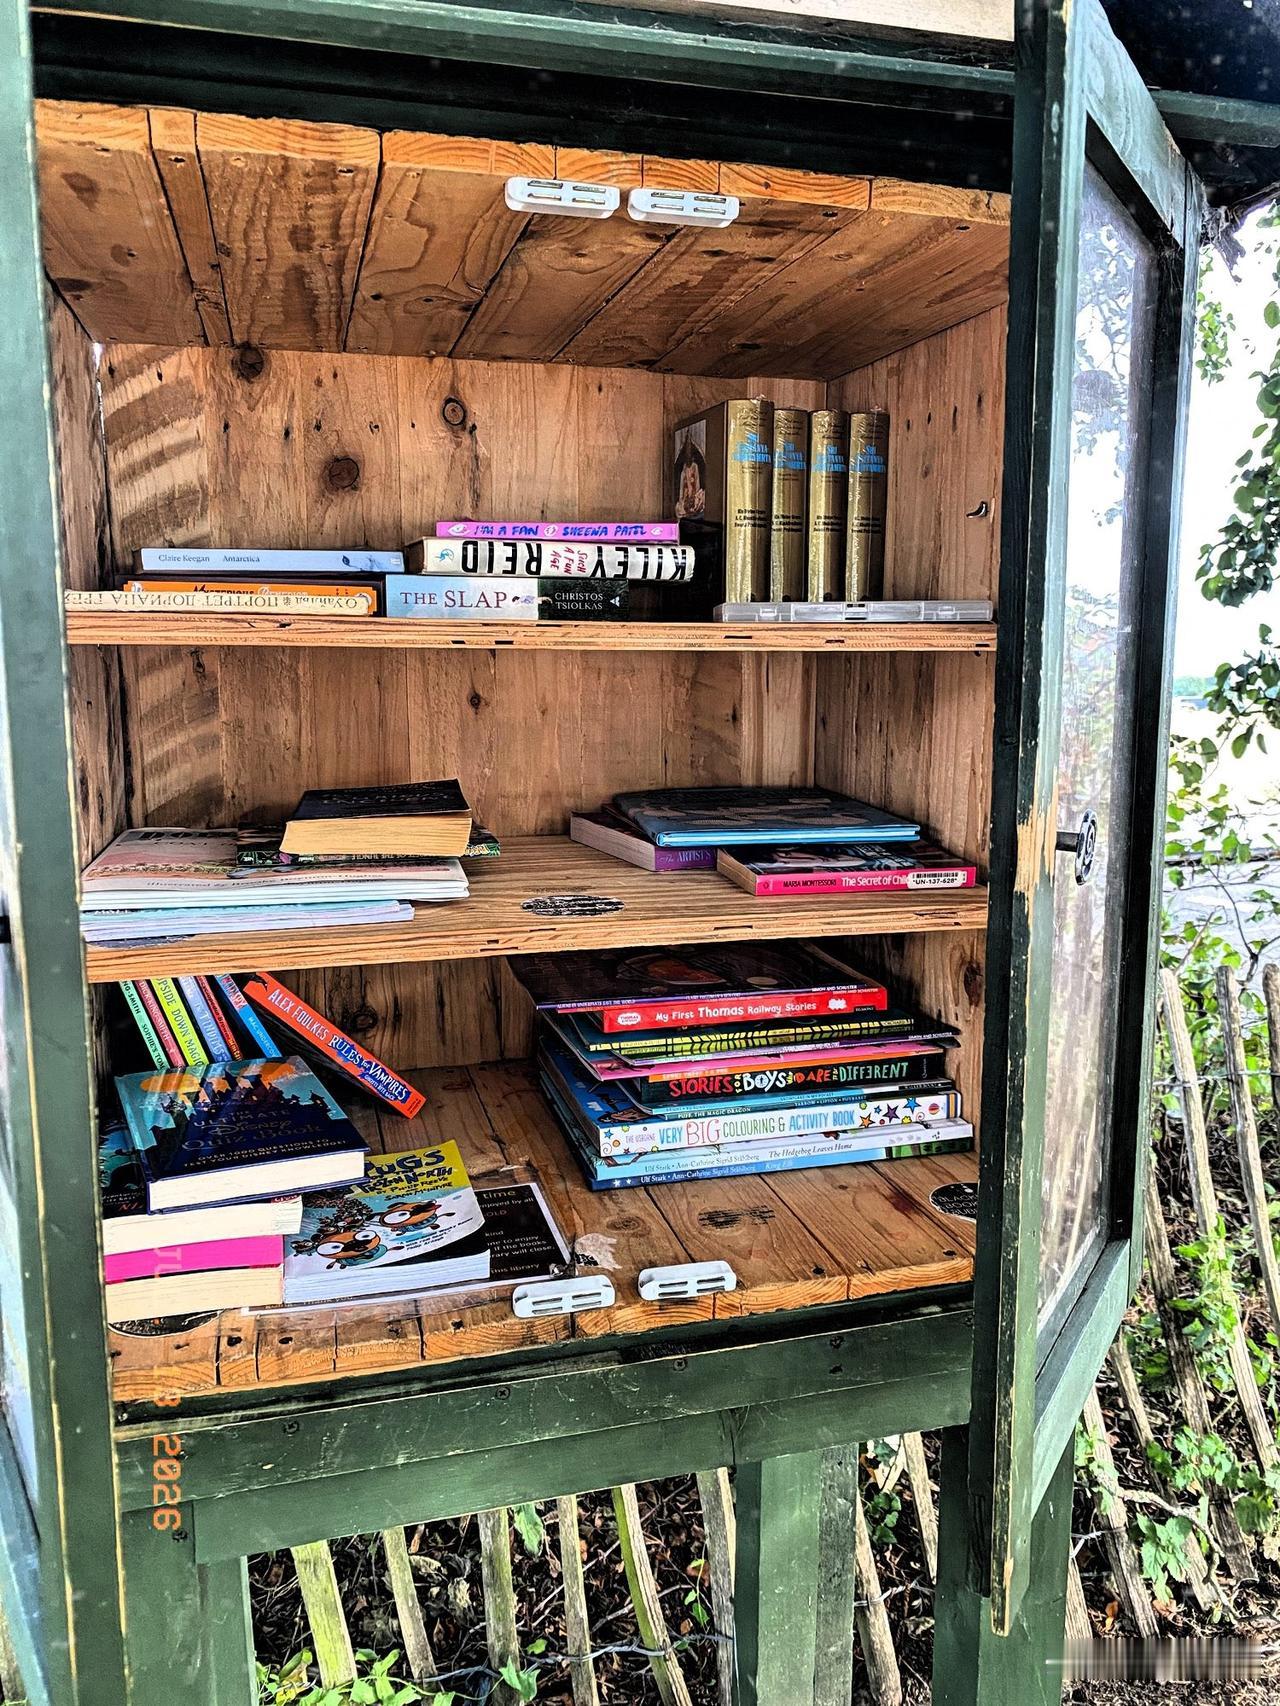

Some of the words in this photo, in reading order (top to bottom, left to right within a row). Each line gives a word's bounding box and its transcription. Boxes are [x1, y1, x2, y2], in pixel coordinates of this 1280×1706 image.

[498, 526, 507, 536] A
[511, 525, 539, 537] FAN
[562, 525, 608, 537] SHEENA
[614, 524, 647, 537] PATEL
[158, 554, 181, 563] Claire
[182, 554, 211, 565] Keegan
[222, 554, 261, 564] Antarctica
[461, 541, 543, 576] REID
[590, 545, 687, 580] KILEY
[205, 595, 278, 608] ПОРТРЕТ
[400, 591, 437, 605] THE
[444, 590, 508, 610] SLAP
[554, 592, 604, 602] CHRISTOS
[555, 601, 604, 611] TSIOLKAS
[783, 879, 801, 889] MARIA
[802, 878, 837, 888] MONTESSORI
[841, 875, 856, 887] The
[857, 875, 880, 886] Secret
[882, 875, 892, 886] of
[122, 981, 141, 1015] NG-SMITH
[142, 1023, 159, 1053] SOPHIE'S
[268, 988, 294, 1013] ALEX
[292, 1007, 330, 1041] FOULKES
[656, 1012, 668, 1022] My
[672, 1010, 694, 1019] First
[698, 1004, 744, 1017] Thomas
[747, 1005, 782, 1016] Railway
[785, 1002, 817, 1012] Stories
[171, 1008, 190, 1038] DOWN
[185, 1038, 205, 1067] MAGIC
[256, 1029, 277, 1058] UNDERCOV
[328, 1034, 361, 1065] RULES
[368, 1061, 408, 1101] VAMPIRES
[669, 1077, 734, 1098] STORIES
[742, 1070, 787, 1092] BOYS
[839, 1062, 909, 1082] DIFFERENT
[193, 1109, 291, 1127] ULTIMATE
[659, 1128, 683, 1146] VERY
[686, 1118, 721, 1146] BIG
[723, 1118, 775, 1138] COLOURING
[778, 1117, 787, 1131] &
[789, 1113, 829, 1132] ACTIVITY
[832, 1109, 857, 1126] BOOK
[184, 1160, 207, 1168] TEST
[208, 1155, 240, 1164] YOUR
[242, 1150, 278, 1159] DISNEY
[198, 1153, 225, 1161] OVER
[257, 1140, 314, 1152] QUESTIONS
[676, 1158, 716, 1171] Ann-Cathrine
[717, 1156, 732, 1168] Sigrid
[768, 1150, 781, 1158] The
[782, 1145, 811, 1157] Hedgehog
[812, 1143, 833, 1153] Leaves
[834, 1142, 853, 1151] Home
[404, 1166, 453, 1184] NORTH
[641, 1174, 651, 1184] Ulf
[652, 1173, 667, 1183] Stark
[671, 1169, 711, 1181] Ann-Cathrine
[712, 1167, 728, 1179] Sigrid
[483, 1190, 516, 1199] time
[486, 1209, 508, 1217] OLD
[511, 1248, 528, 1256] will
[520, 1240, 547, 1248] books
[510, 1262, 540, 1272] library
